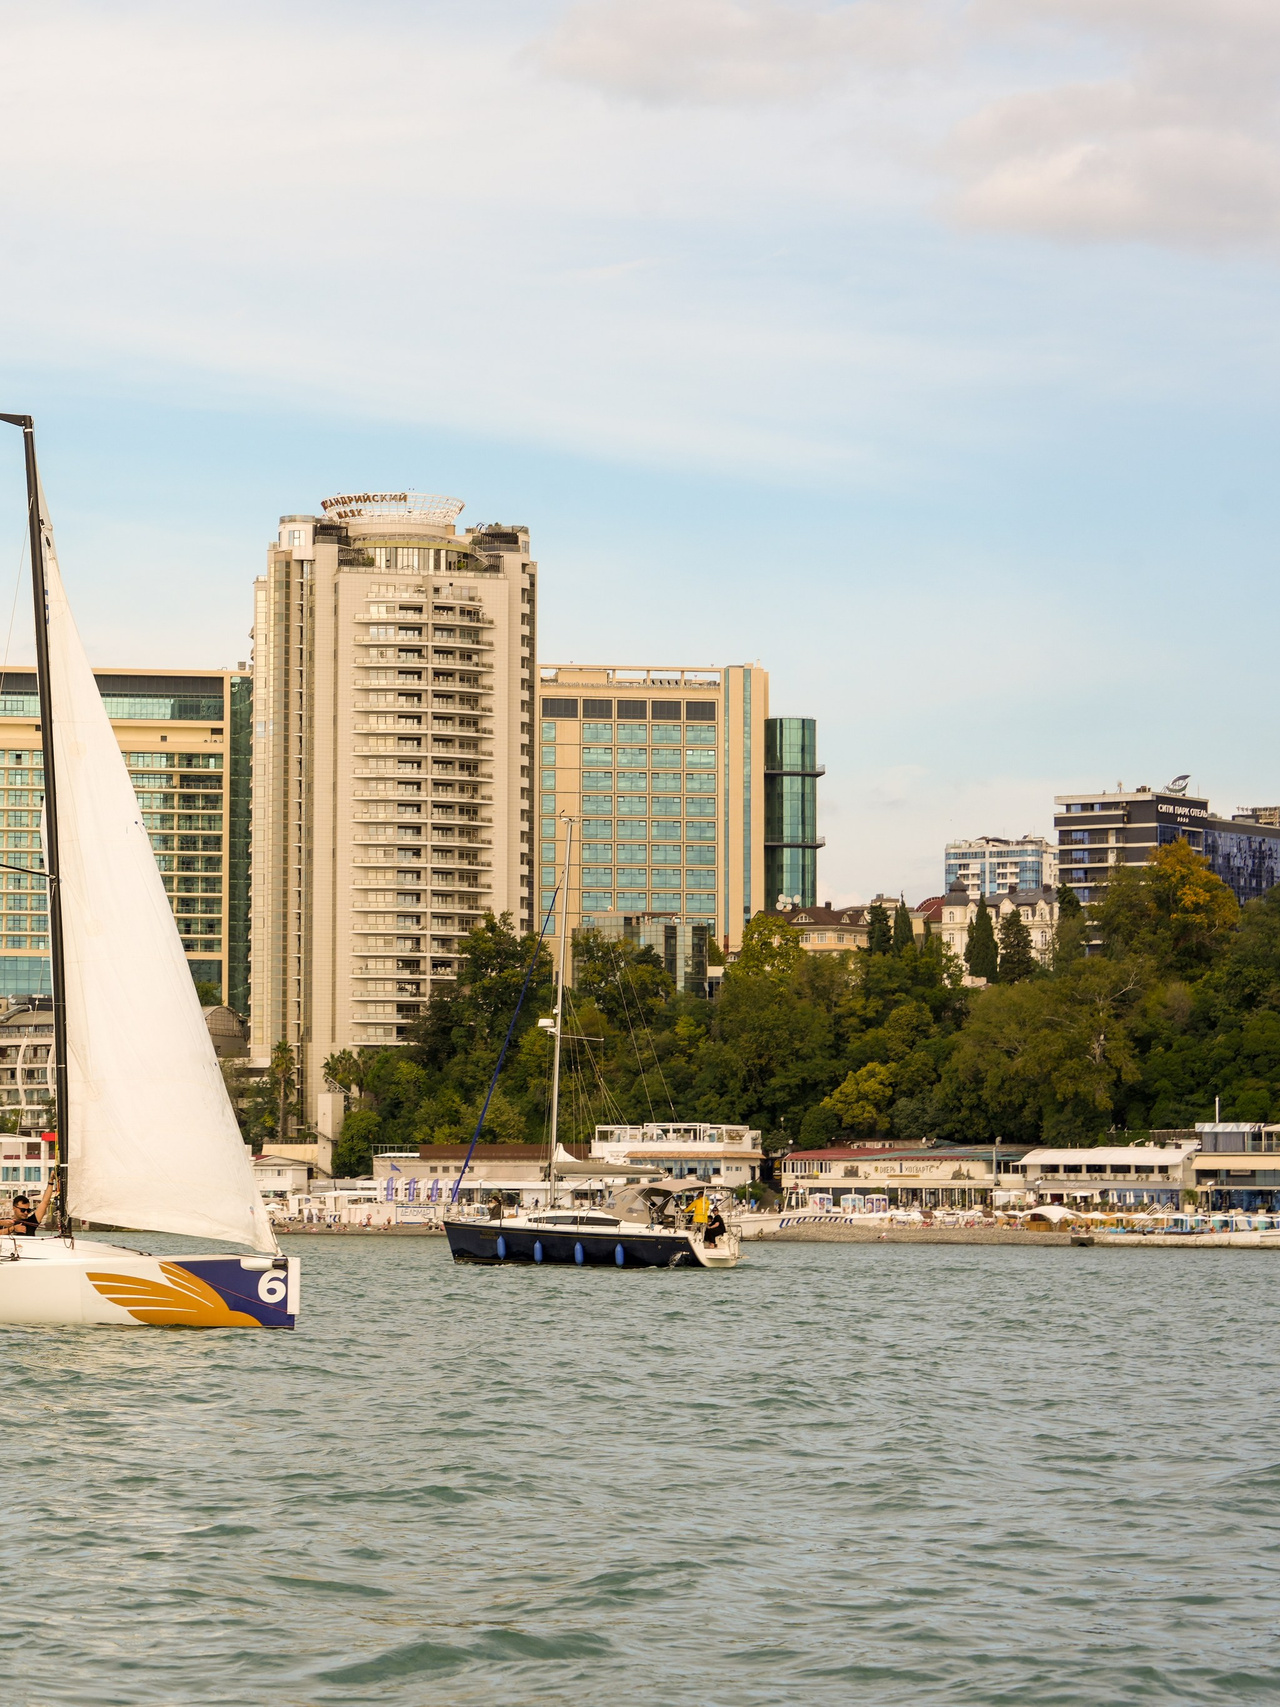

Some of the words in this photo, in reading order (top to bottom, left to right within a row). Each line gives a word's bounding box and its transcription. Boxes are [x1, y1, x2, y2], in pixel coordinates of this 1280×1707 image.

[1158, 804, 1174, 813] СИТИ
[1175, 806, 1190, 816] ПАРК
[1190, 808, 1208, 818] ОТЕЛЬ
[258, 1269, 287, 1304] 6
